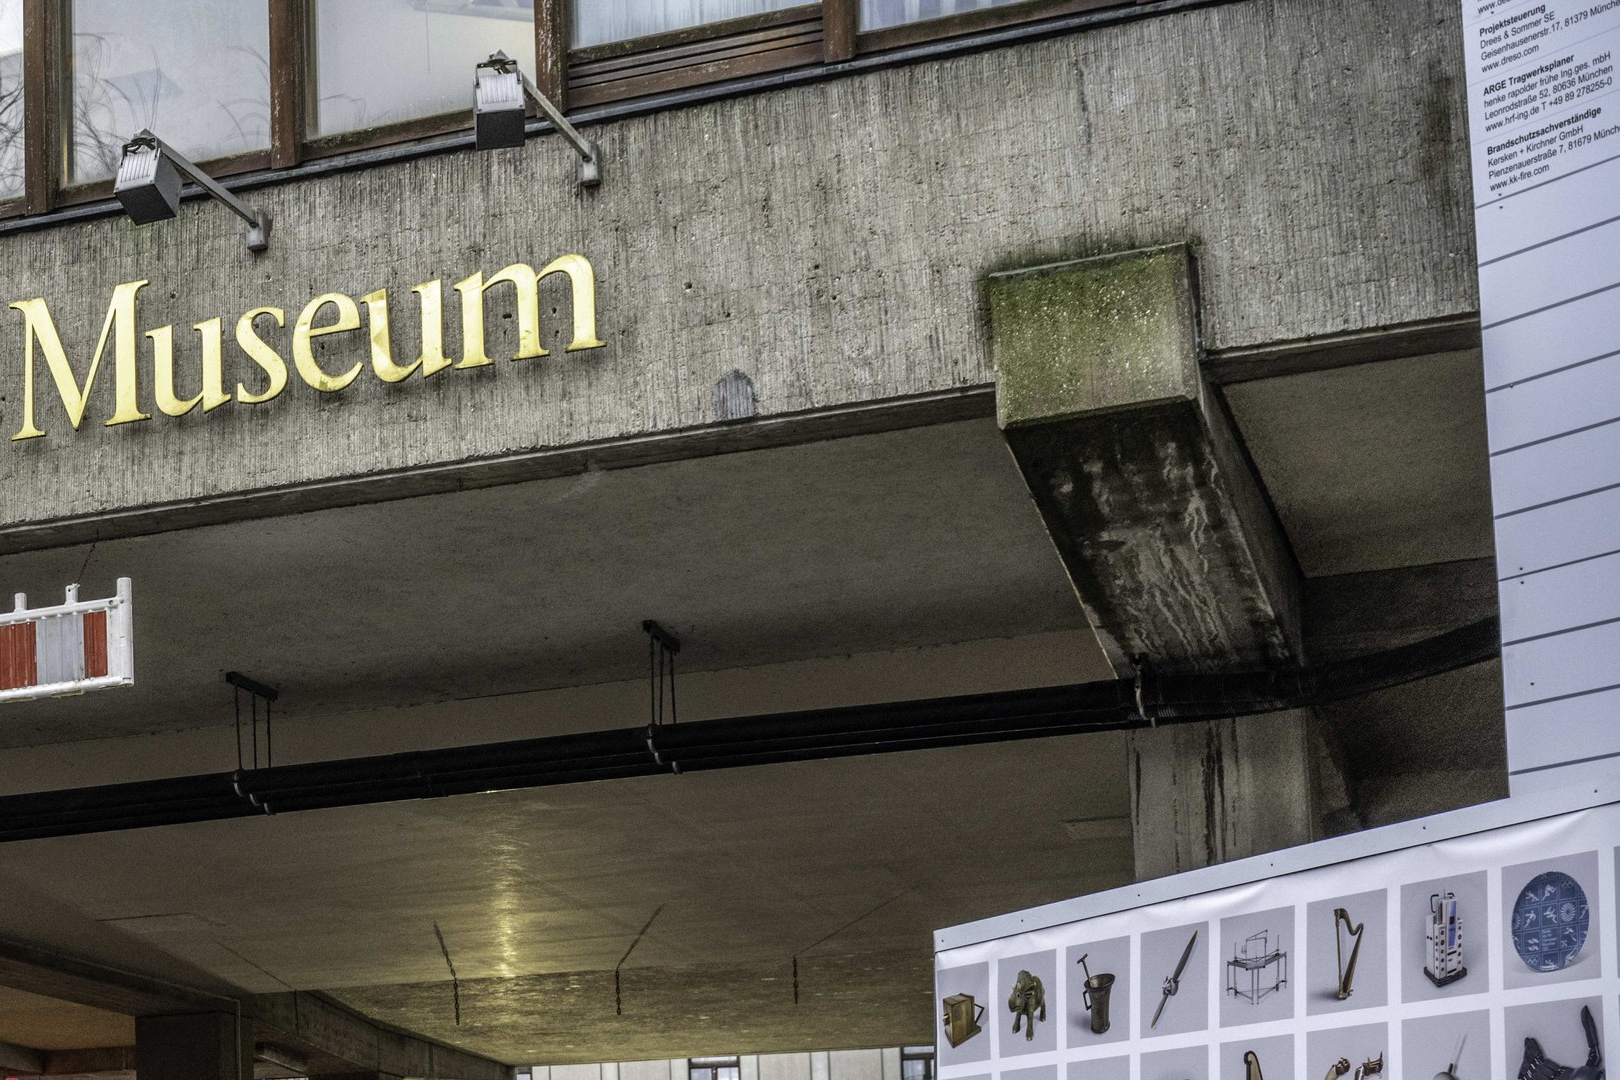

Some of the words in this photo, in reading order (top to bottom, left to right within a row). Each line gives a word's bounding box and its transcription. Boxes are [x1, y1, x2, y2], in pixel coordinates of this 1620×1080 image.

[1479, 4, 1546, 37] Projektsteuerung
[1480, 35, 1502, 49] Drees
[1504, 30, 1509, 38] &
[1511, 18, 1542, 36] Sommer
[1544, 11, 1555, 23] SE
[1564, 11, 1588, 27] 81379
[1481, 44, 1539, 73] www.dreso.com
[1483, 80, 1507, 96] ARGE
[1508, 54, 1575, 86] Tragwerksplaner
[1484, 93, 1506, 108] henke
[1507, 82, 1538, 99] rapolder
[1539, 74, 1559, 87] frühe
[1592, 51, 1611, 66] mbH
[1484, 95, 1538, 120] Leonrodstraße
[1552, 78, 1576, 94] 80636
[1577, 65, 1613, 84] München
[1541, 101, 1547, 111] T
[1548, 96, 1563, 107] +49
[1564, 91, 1574, 102] 89
[1576, 76, 1613, 98] 278255-0
[1487, 107, 1602, 155] Brandschutzsachverständige
[1487, 151, 1518, 168] Kersken
[1526, 135, 1557, 153] Kirchner
[1559, 124, 1584, 141] GmbH
[1488, 148, 1557, 180] Pienzenauerstraße
[1568, 134, 1592, 150] 81679
[1593, 125, 1620, 141] Münch
[1489, 164, 1550, 192] www.kk-fire.com
[10, 253, 606, 442] Museum
